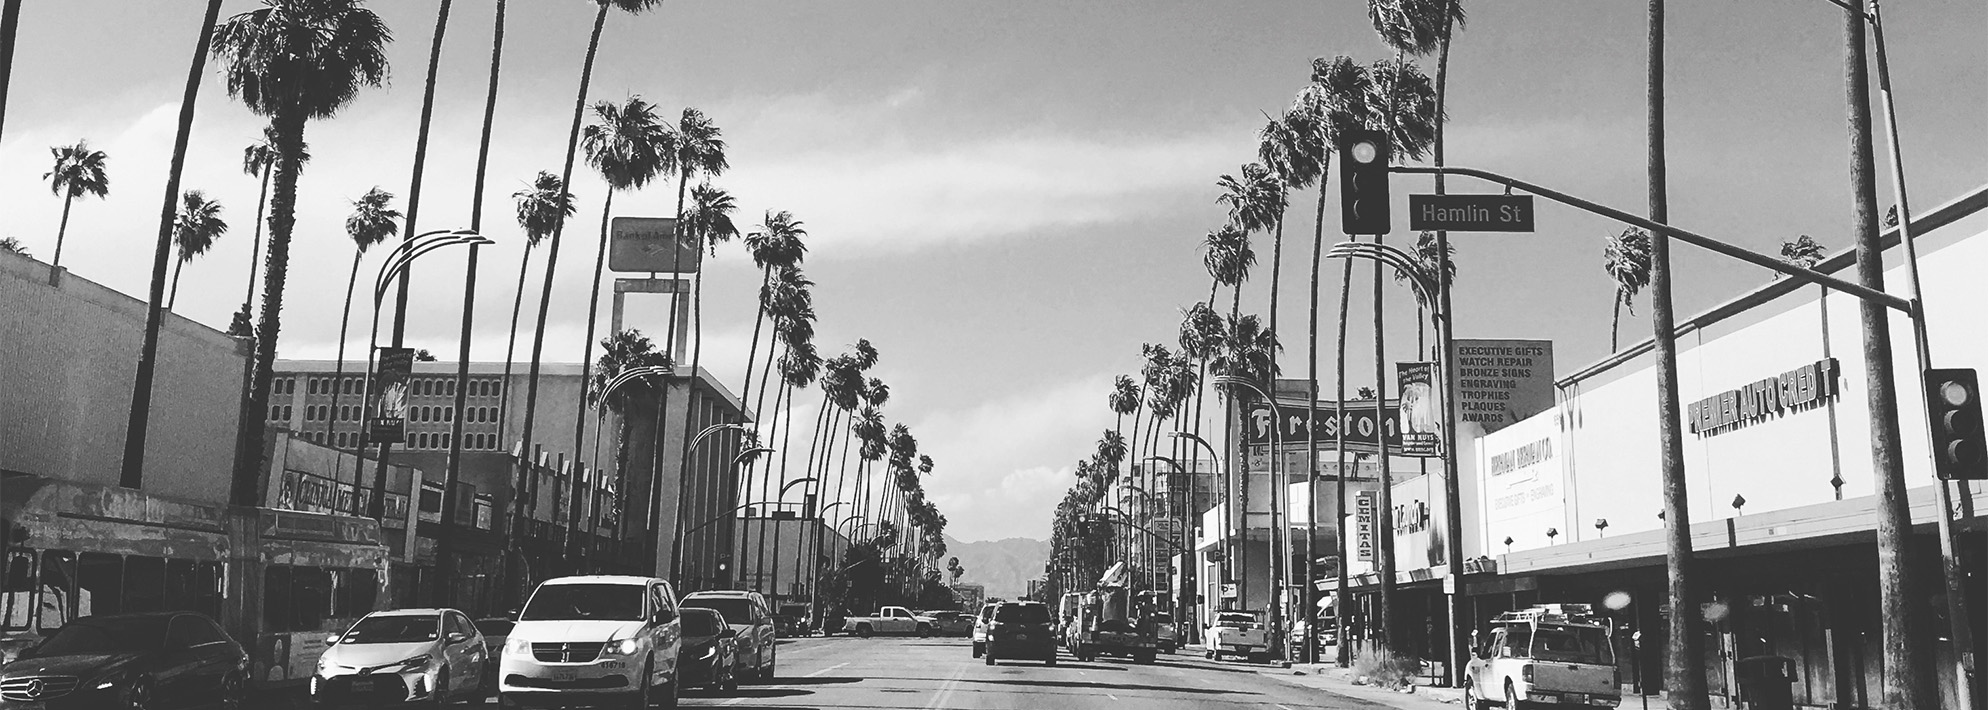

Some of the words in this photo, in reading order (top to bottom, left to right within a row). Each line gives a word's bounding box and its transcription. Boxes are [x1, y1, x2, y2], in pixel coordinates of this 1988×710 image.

[1422, 204, 1489, 222] Hamlin
[1500, 204, 1521, 222] St
[1458, 346, 1513, 356] EXECUTIVE
[1515, 347, 1543, 356] GIFTS
[1459, 357, 1494, 366] WATCH
[1497, 358, 1532, 366] REPAIR
[1460, 368, 1499, 377] BRONZE
[1502, 368, 1531, 378] SIGNS
[1460, 379, 1516, 389] ENGRAVING
[1461, 390, 1510, 400] TROPHIES
[1461, 401, 1506, 411] PLAQUES
[1688, 390, 1739, 434] PREMIER
[1740, 376, 1776, 420] AUTO
[1461, 413, 1504, 423] AWARDS
[1358, 499, 1372, 557] CEMITAS
